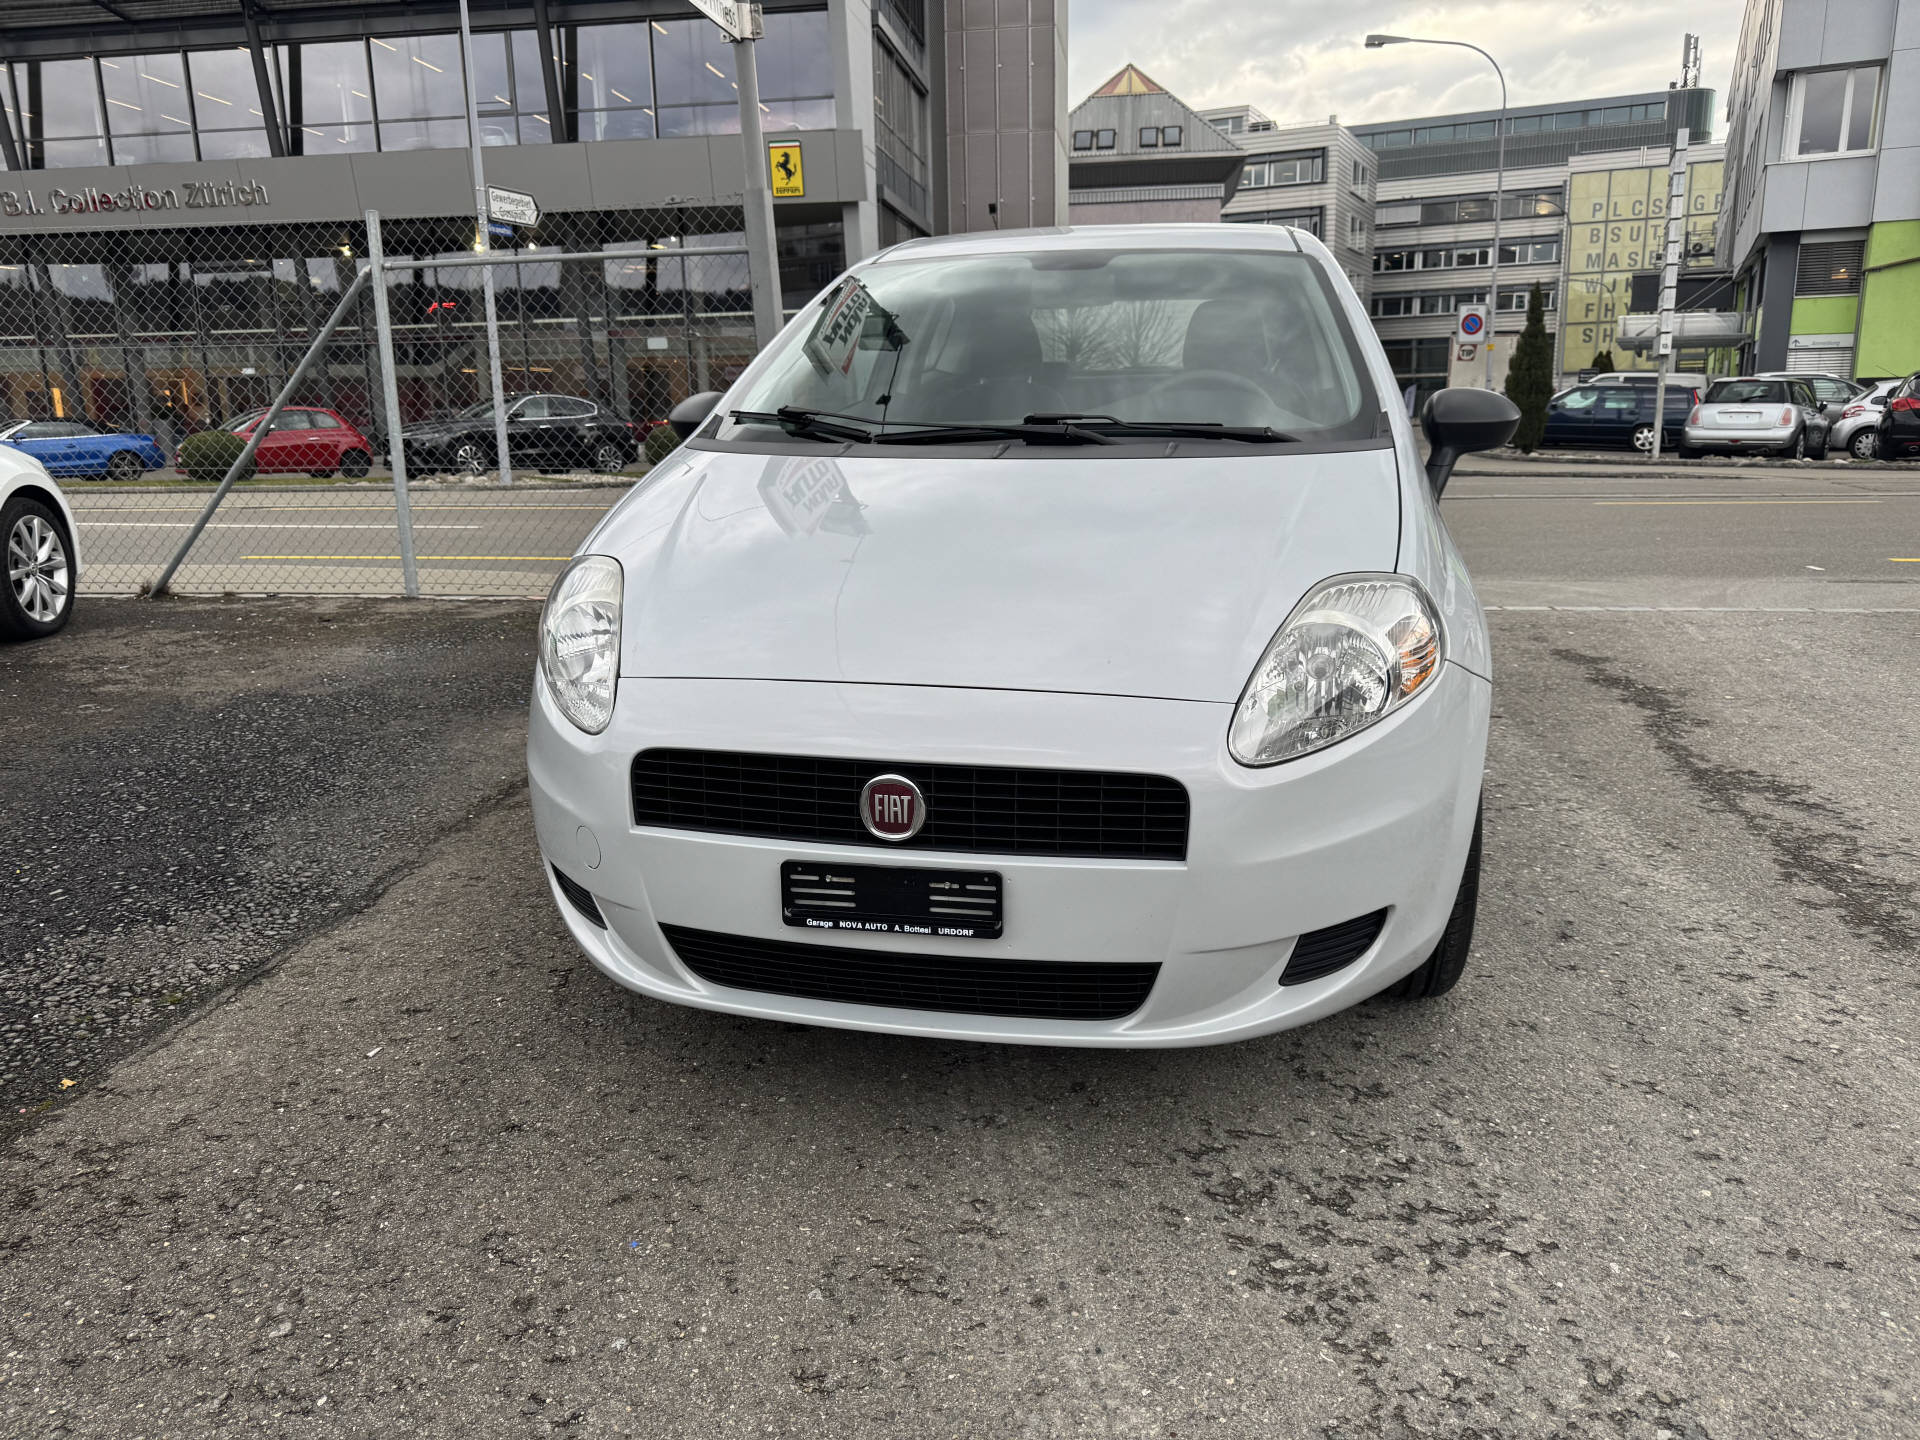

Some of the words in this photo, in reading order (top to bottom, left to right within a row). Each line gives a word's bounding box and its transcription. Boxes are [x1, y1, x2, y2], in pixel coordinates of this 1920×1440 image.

[50, 185, 181, 214] Collection
[182, 178, 270, 209] Zürich
[874, 793, 912, 824] FIAT
[806, 918, 834, 928] Garage
[839, 920, 863, 929] NOVA
[864, 922, 888, 931] AUTO
[894, 924, 902, 932] A.
[938, 927, 974, 937] URDORF
